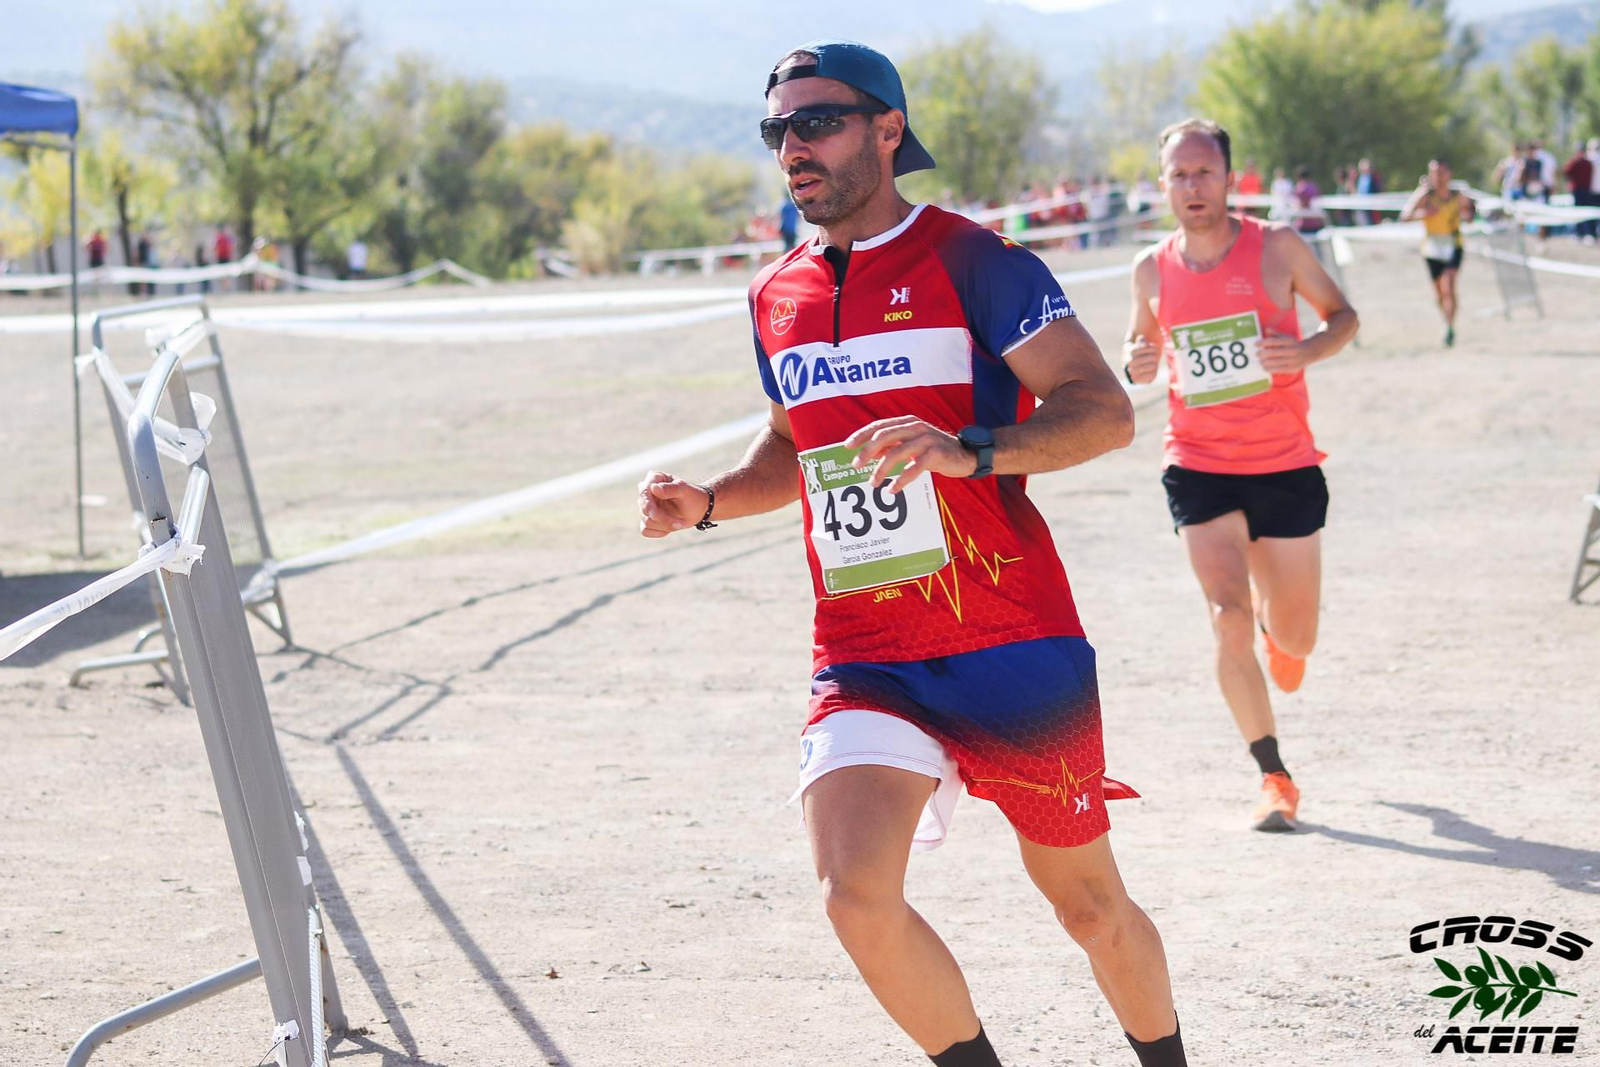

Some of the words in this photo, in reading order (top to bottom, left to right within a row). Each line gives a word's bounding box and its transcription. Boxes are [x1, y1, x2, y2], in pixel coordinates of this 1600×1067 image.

[884, 310, 913, 323] KIKO
[828, 355, 851, 365] GRUPO
[1188, 341, 1249, 377] 368
[812, 356, 912, 387] Avanza
[823, 471, 849, 481] Campo
[824, 478, 908, 541] 439
[840, 541, 868, 553] Francisco
[870, 537, 890, 547] Javier
